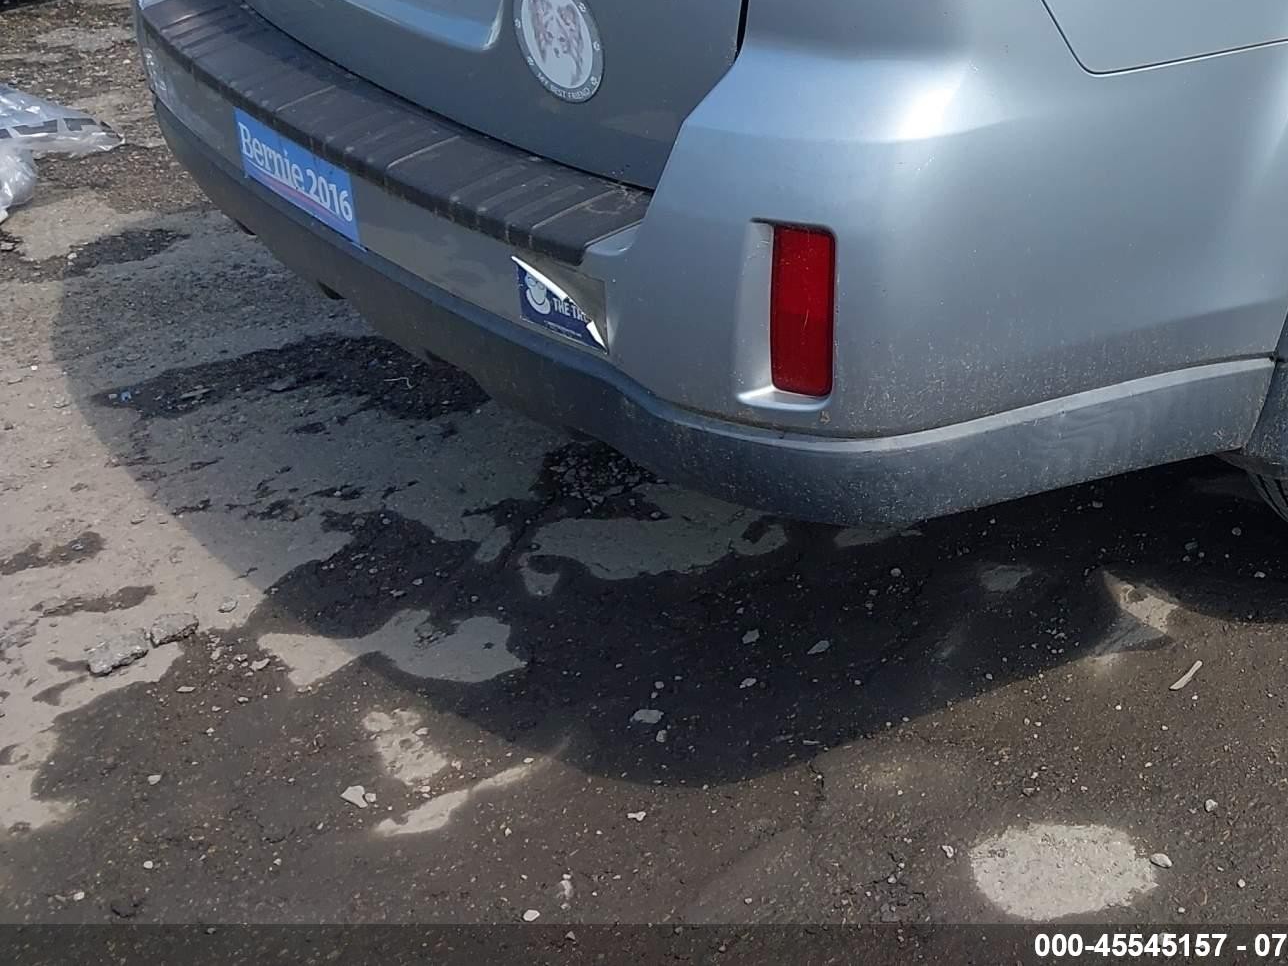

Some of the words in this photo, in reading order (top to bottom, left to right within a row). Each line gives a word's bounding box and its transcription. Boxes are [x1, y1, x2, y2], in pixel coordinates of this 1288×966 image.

[237, 121, 305, 192] Bernie
[305, 168, 353, 223] 2016
[552, 297, 571, 317] THE
